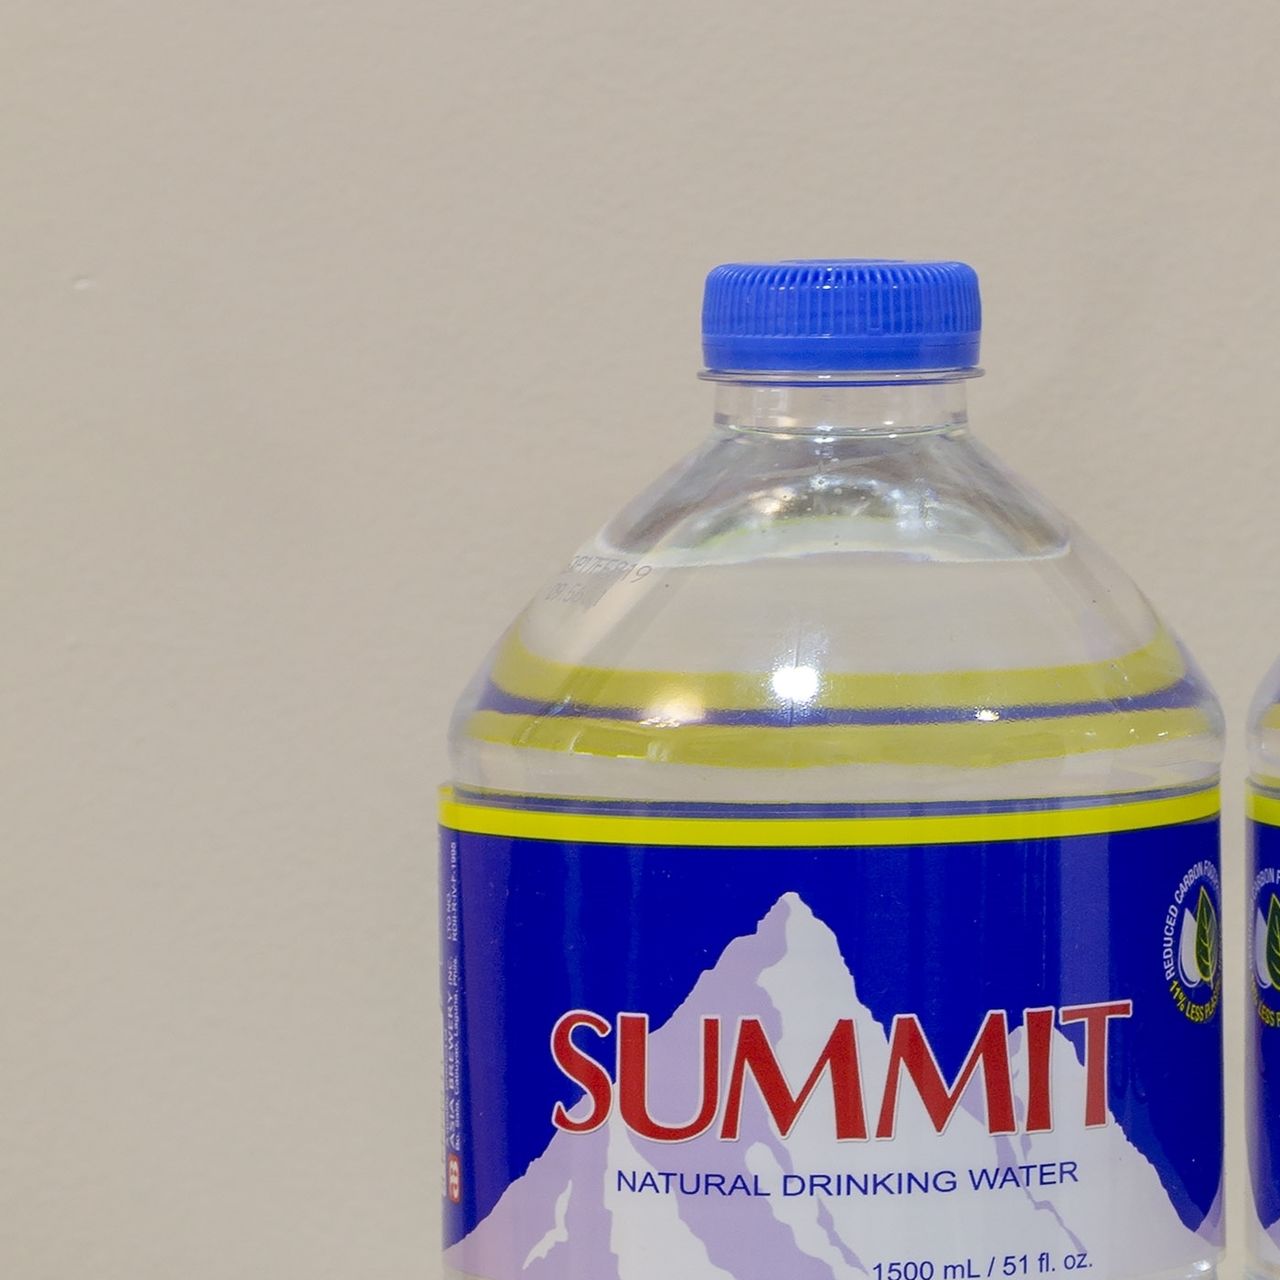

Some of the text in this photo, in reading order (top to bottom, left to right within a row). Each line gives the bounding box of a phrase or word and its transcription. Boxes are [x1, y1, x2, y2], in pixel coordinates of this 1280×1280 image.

[1162, 861, 1204, 980] REDUCED CARBON
[1169, 980, 1185, 1012] 11%
[1185, 1002, 1206, 1023] LESS
[551, 1000, 1133, 1143] SUMMIT
[616, 1161, 1080, 1197] NATURAL DRINKING WATER
[943, 1258, 981, 1280] mL
[1002, 1254, 1030, 1277] 51
[1037, 1252, 1057, 1274] fl.
[1063, 1253, 1094, 1271] oz.
